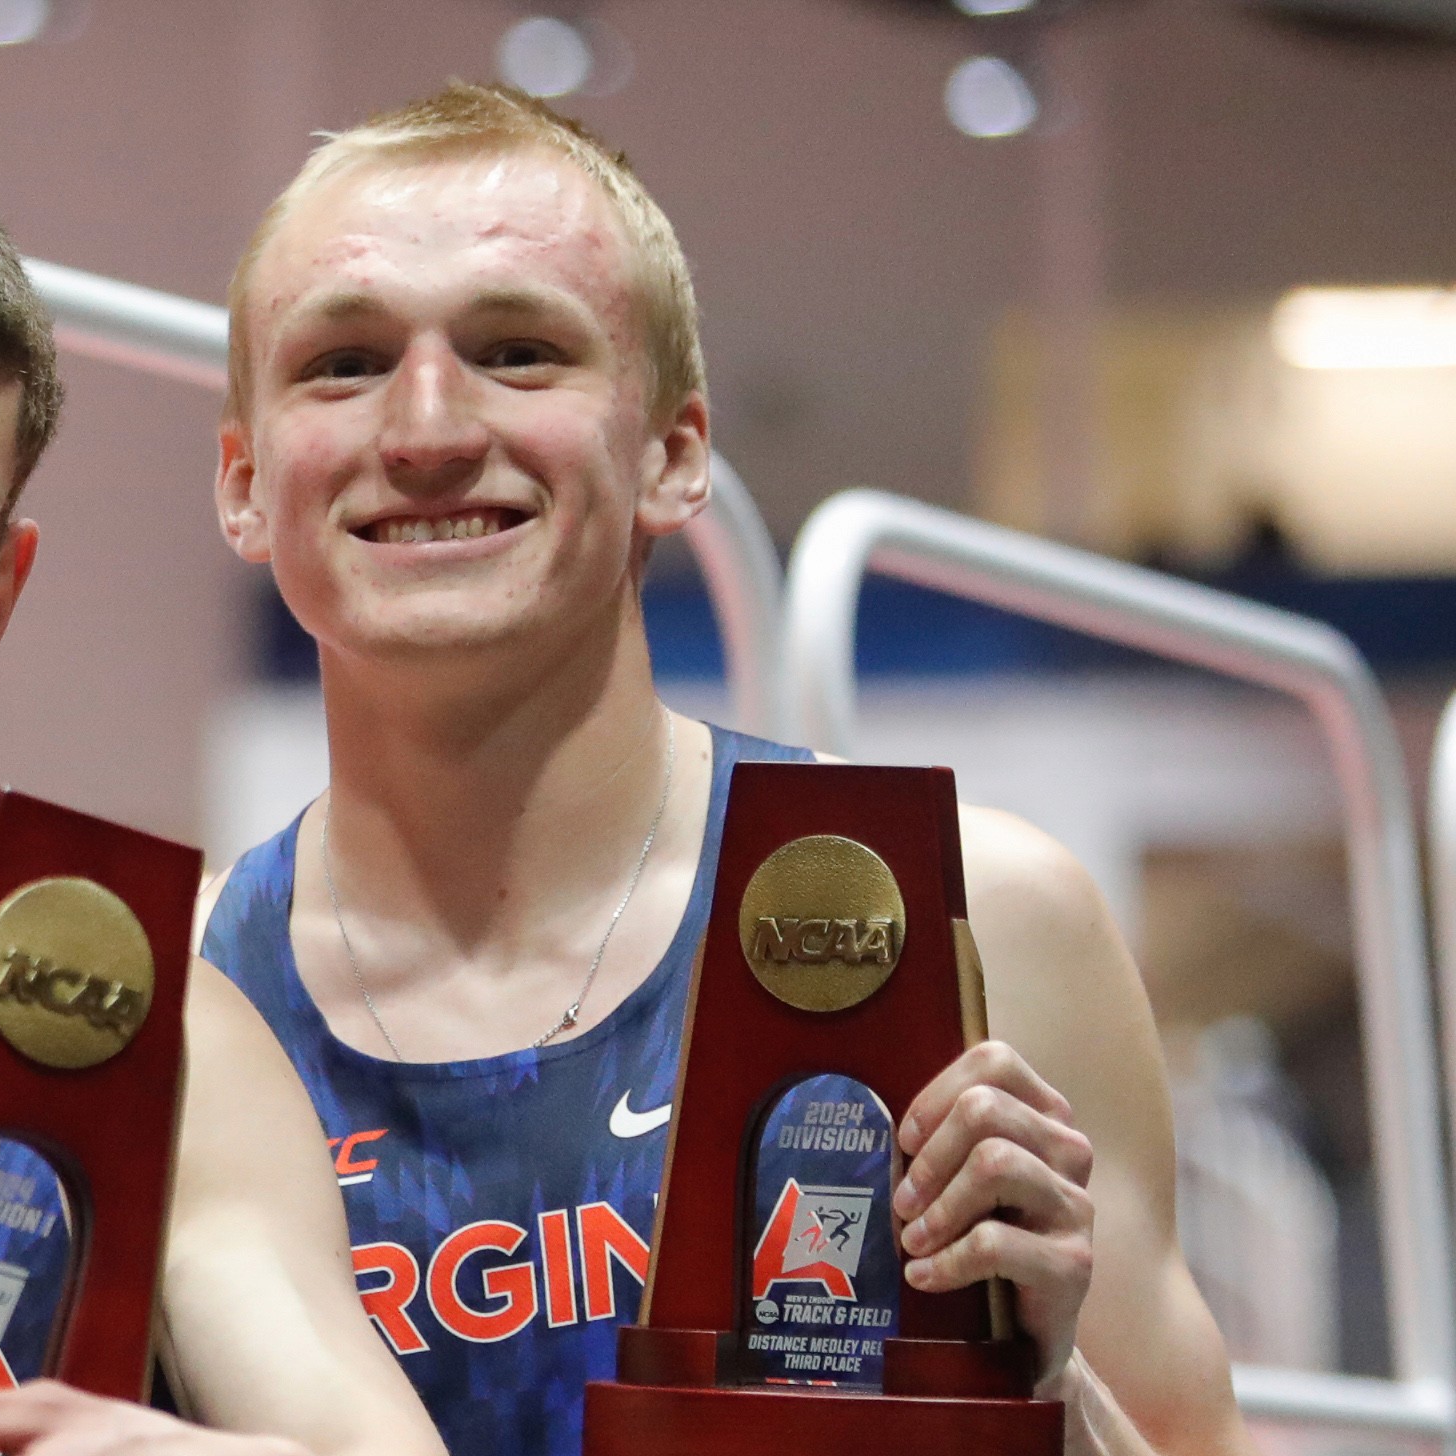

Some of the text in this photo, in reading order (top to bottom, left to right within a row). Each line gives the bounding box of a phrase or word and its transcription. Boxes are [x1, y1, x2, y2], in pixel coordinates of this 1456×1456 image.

[752, 916, 895, 963] NCAA
[804, 1101, 865, 1126] 2024
[778, 1125, 888, 1152] DIVISION I
[783, 1304, 892, 1327] TRACK & FIELD
[748, 1334, 883, 1356] DISTANCE MEDLEY REL
[784, 1354, 862, 1372] THIRD PLACE
